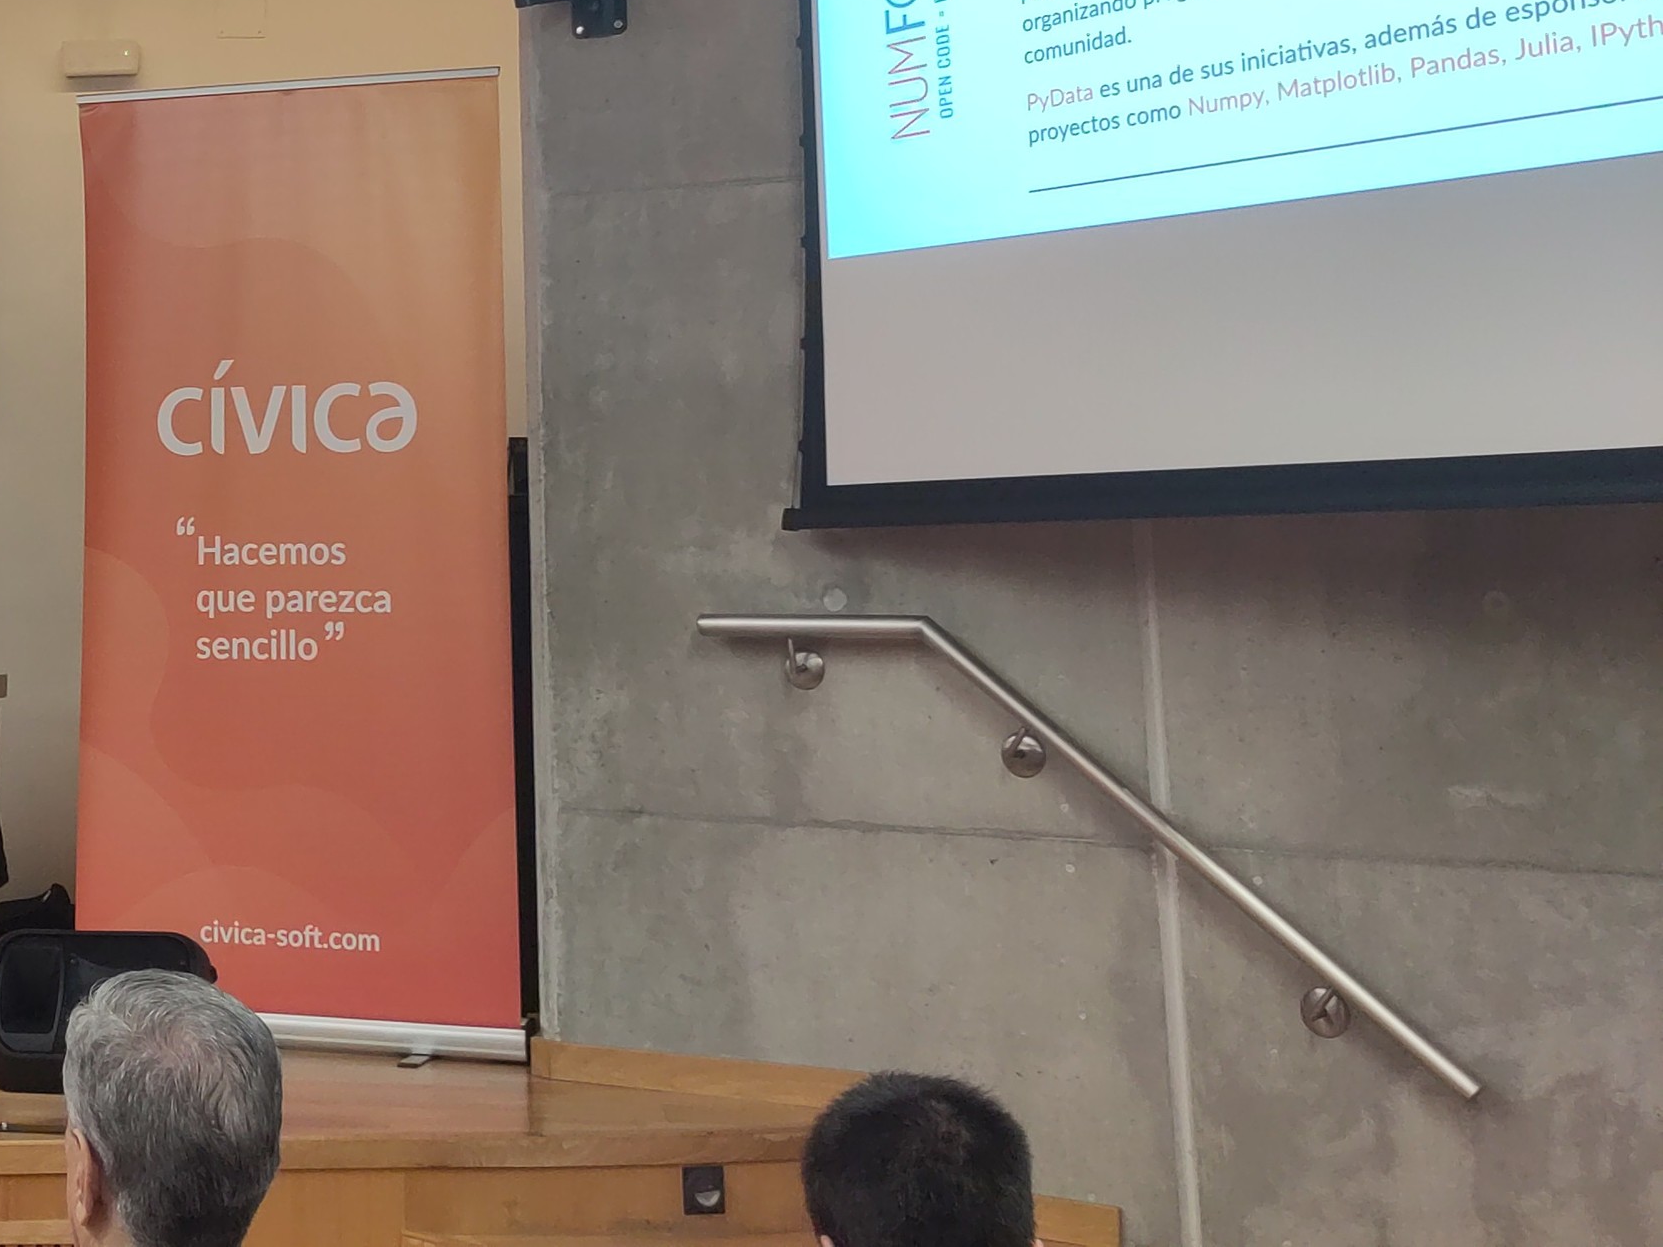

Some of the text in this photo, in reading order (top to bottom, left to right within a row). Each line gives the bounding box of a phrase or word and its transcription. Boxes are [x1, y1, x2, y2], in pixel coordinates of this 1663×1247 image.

[935, 24, 951, 69] CODE
[1024, 25, 1132, 64] comunidad.
[1028, 86, 1093, 113] PyData
[1100, 82, 1121, 97] es
[1126, 74, 1162, 93] una
[1169, 64, 1194, 85] de
[1201, 60, 1234, 79] sus
[1241, 38, 1357, 72] iniciativas,
[1365, 15, 1457, 49] además
[1466, 7, 1496, 30] de
[938, 75, 954, 119] OPEN
[1029, 115, 1120, 148] proyectos
[1126, 105, 1181, 126] como
[1189, 90, 1269, 116] Numpy,
[1278, 63, 1401, 101] Matplotlib,
[1411, 47, 1506, 78] Pandas,
[1515, 32, 1581, 60] Julia,
[196, 588, 392, 619] que parezca
[199, 919, 381, 952] civica-soft.com
